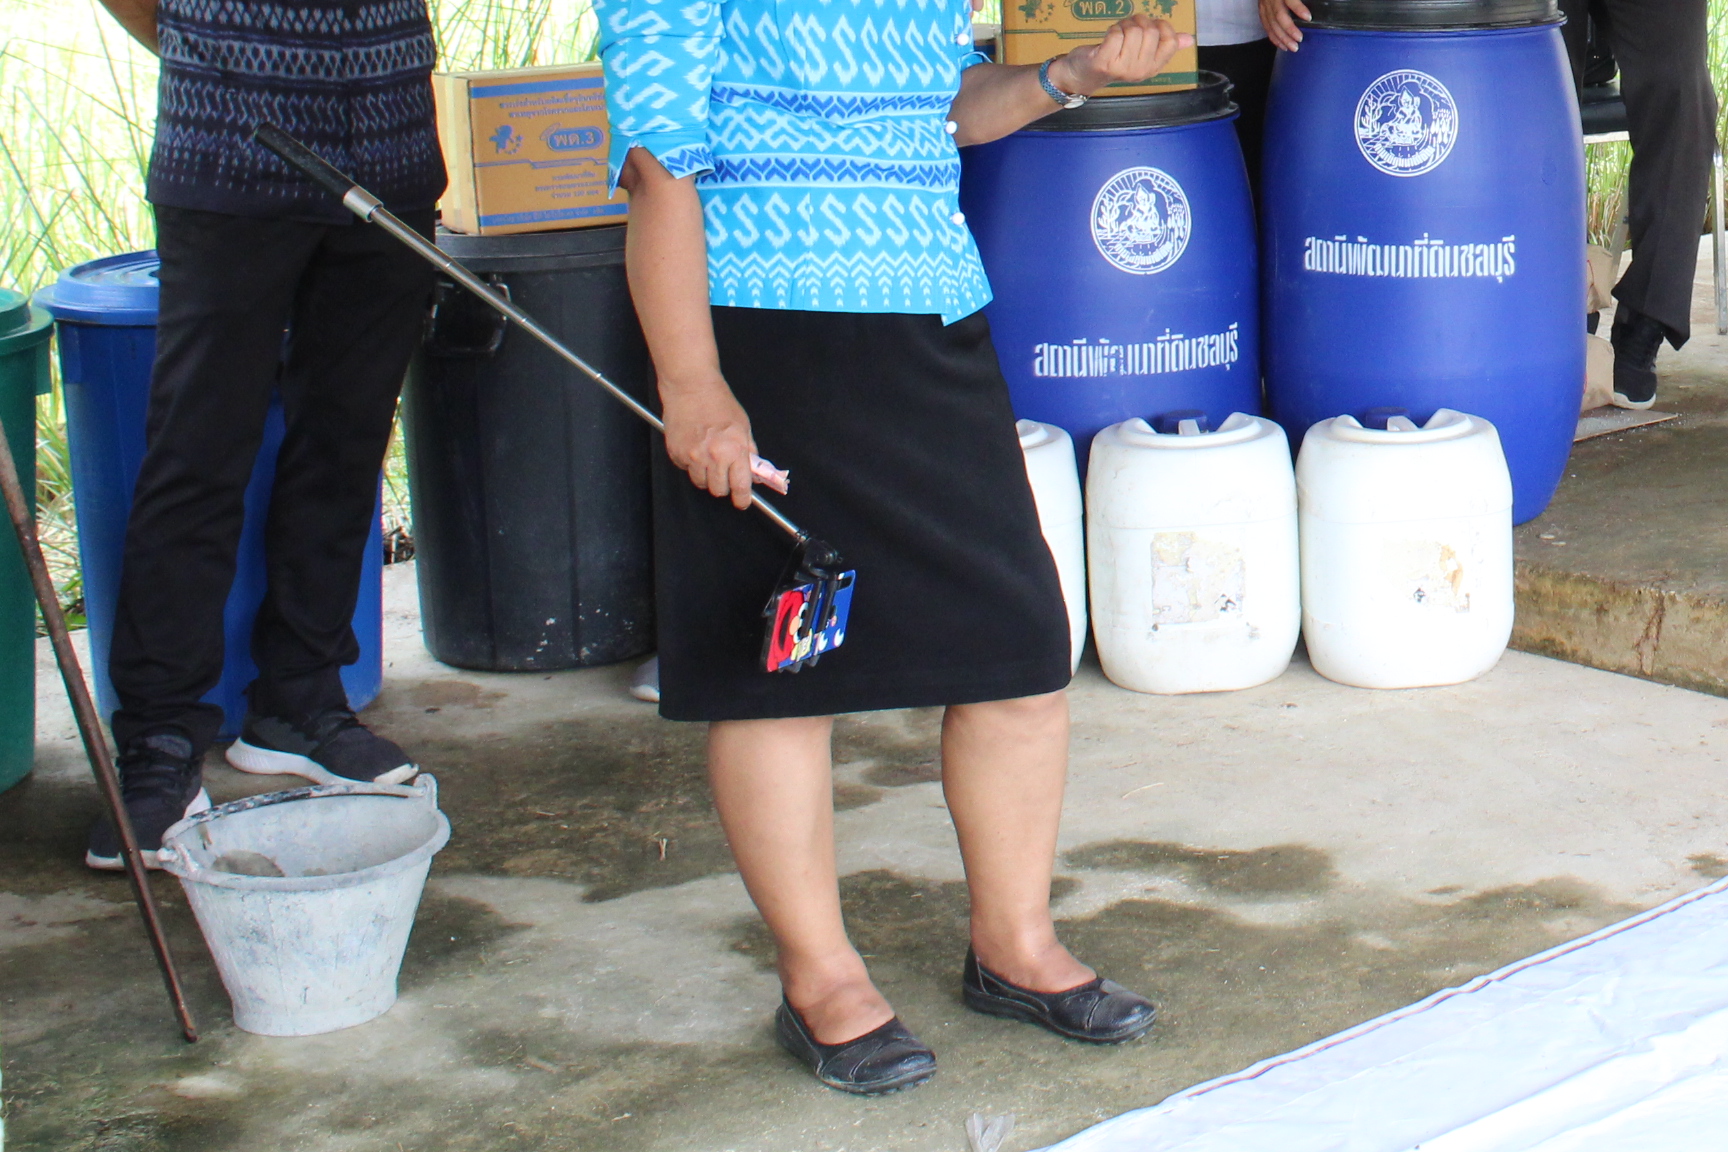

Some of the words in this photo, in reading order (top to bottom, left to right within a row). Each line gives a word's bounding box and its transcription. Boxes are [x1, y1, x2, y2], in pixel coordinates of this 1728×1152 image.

[1304, 232, 1516, 283] สถานีพัฒนาที่ดินชลบุรี
[1034, 321, 1239, 377] สถานีพัฒนาที่ดินชลบุรี
